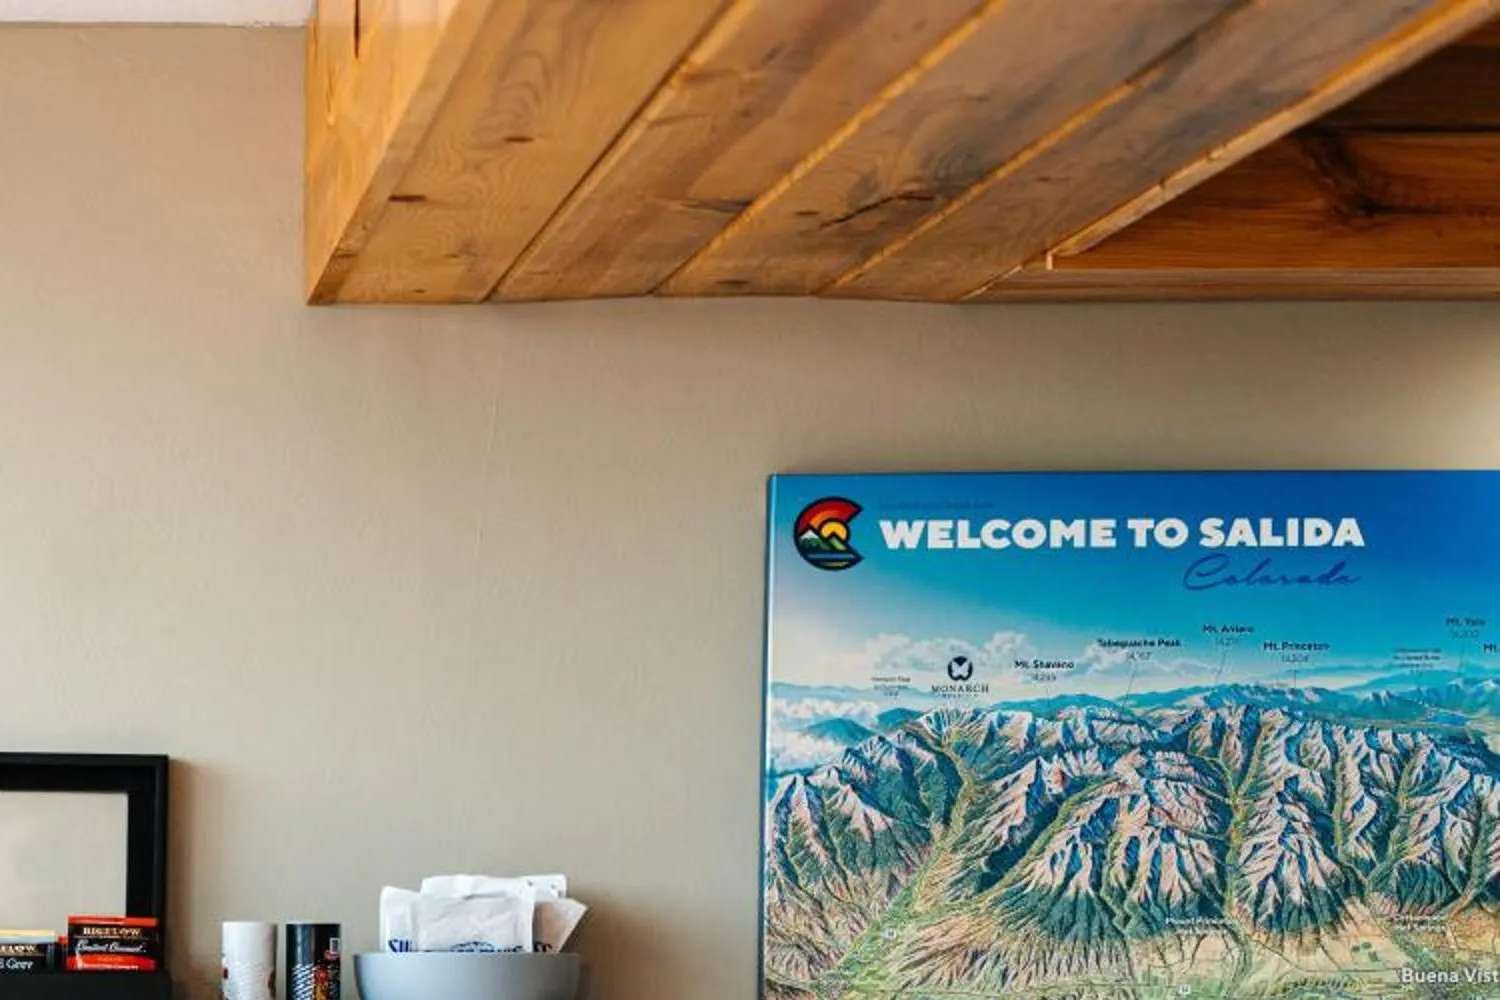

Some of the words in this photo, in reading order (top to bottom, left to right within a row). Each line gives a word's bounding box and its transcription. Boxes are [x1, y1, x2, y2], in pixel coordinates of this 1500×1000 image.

[878, 518, 1117, 549] WELCOME
[1127, 518, 1189, 548] TO
[1199, 517, 1365, 547] SALIDA
[1183, 552, 1361, 591] Colorado
[931, 684, 989, 693] MONARCH
[1401, 967, 1459, 983] Buena
